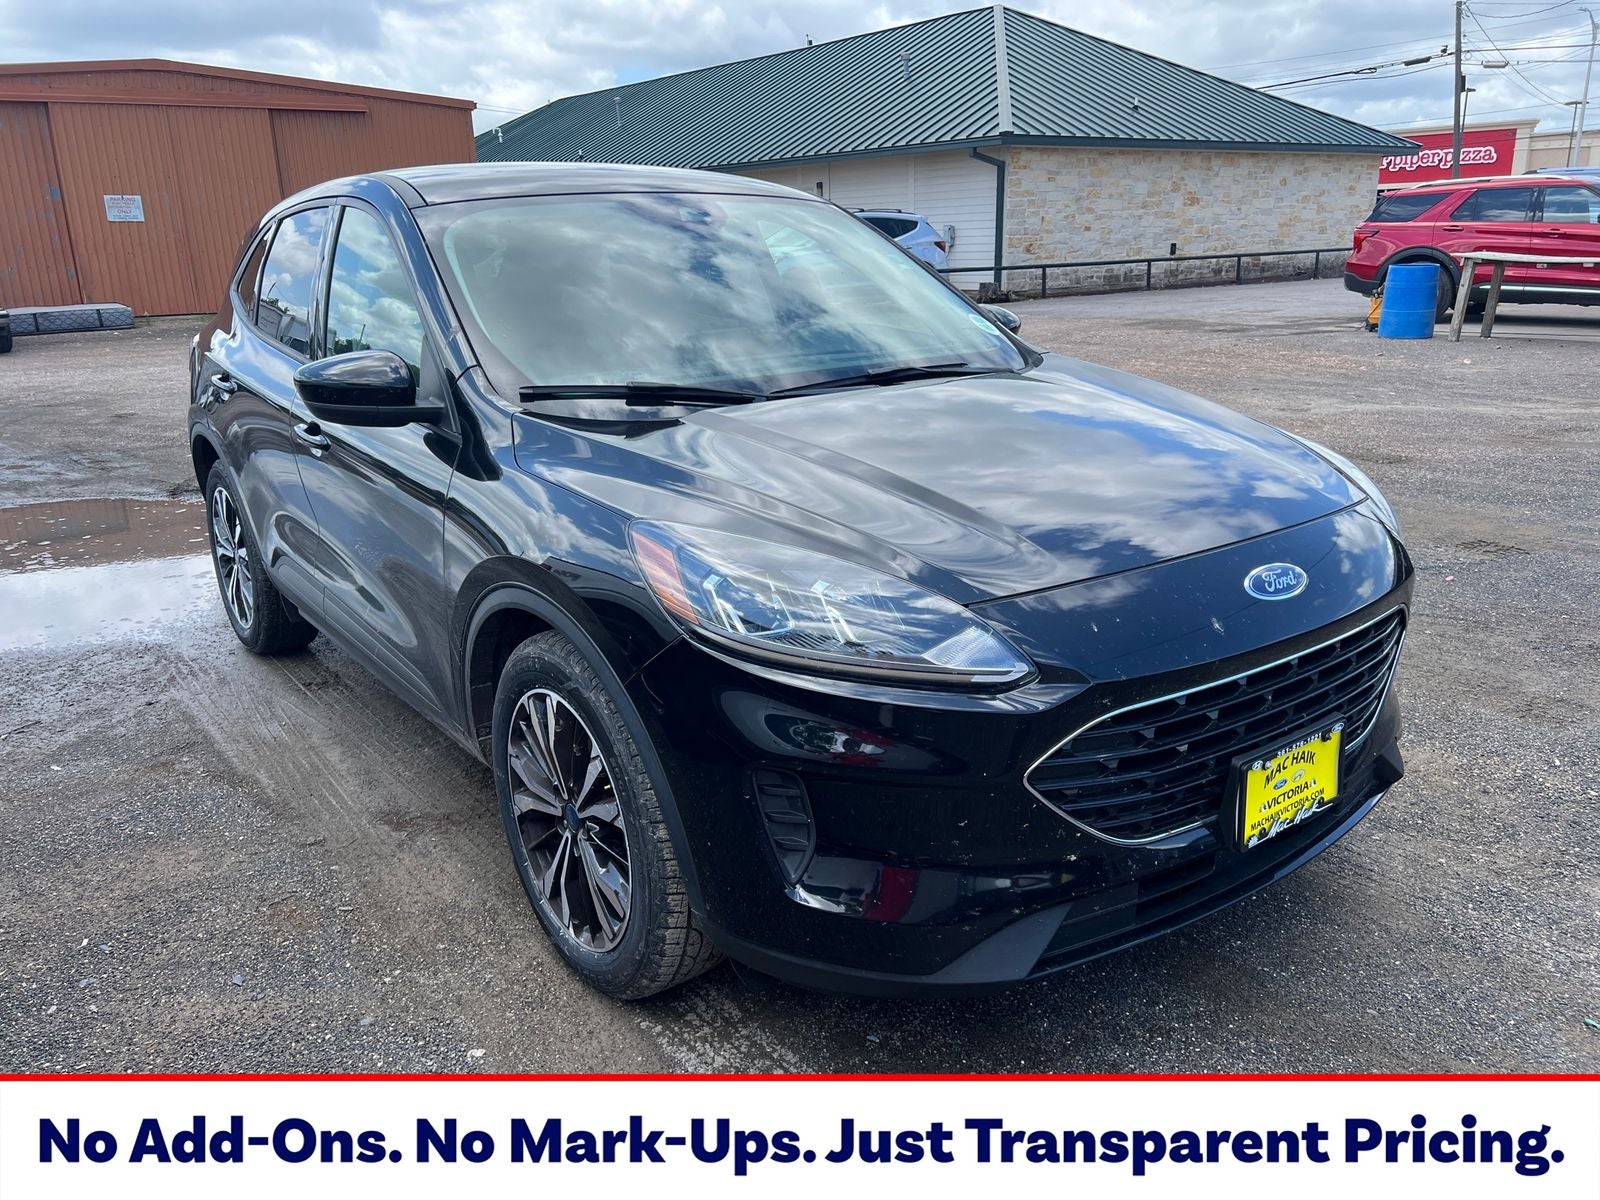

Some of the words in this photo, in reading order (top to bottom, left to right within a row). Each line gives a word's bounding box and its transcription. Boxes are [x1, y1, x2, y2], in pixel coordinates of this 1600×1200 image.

[1389, 149, 1442, 171] piper
[1440, 146, 1496, 169] pzza
[1261, 568, 1298, 592] Ford
[1263, 756, 1290, 789] MAC
[1291, 750, 1316, 766] HAIK
[1250, 787, 1325, 832] MACHAIKVICTORIA.COM
[1266, 781, 1309, 810] VICTORIA
